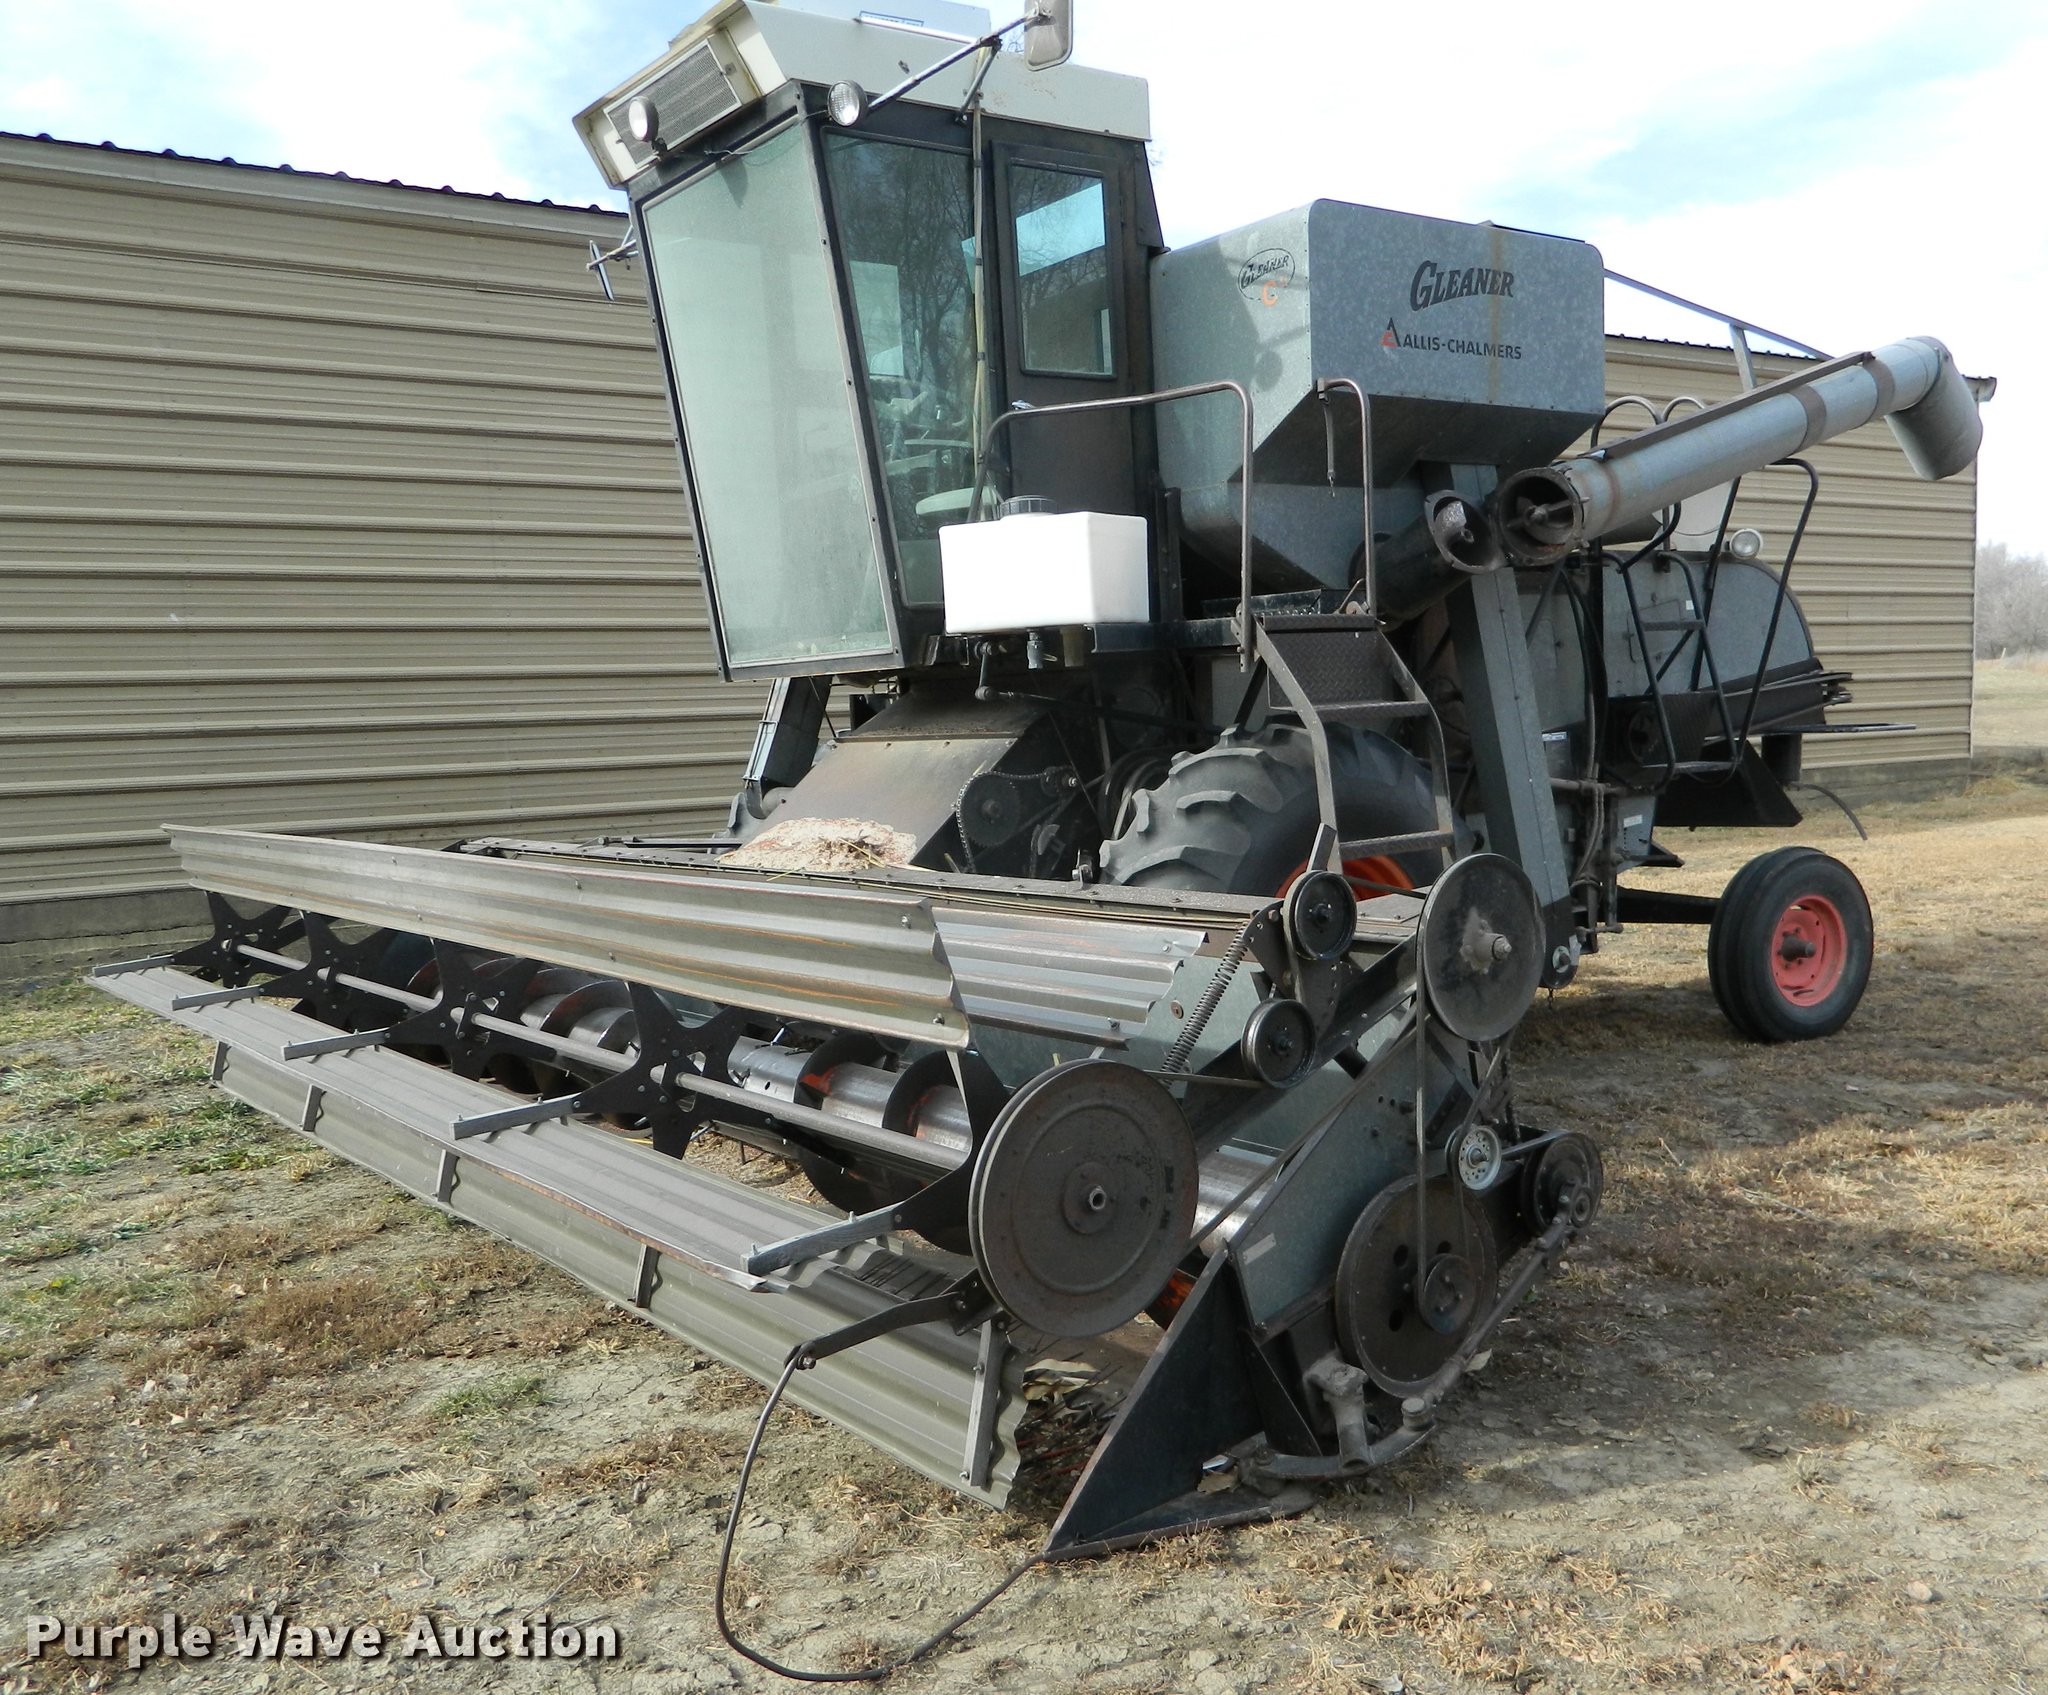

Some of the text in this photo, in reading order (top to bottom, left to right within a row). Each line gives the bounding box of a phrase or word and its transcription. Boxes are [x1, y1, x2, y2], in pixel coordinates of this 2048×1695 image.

[1240, 255, 1290, 290] GLEANER
[1409, 260, 1514, 312] GLEANER
[1402, 333, 1522, 360] ALLIS-CHALMERS
